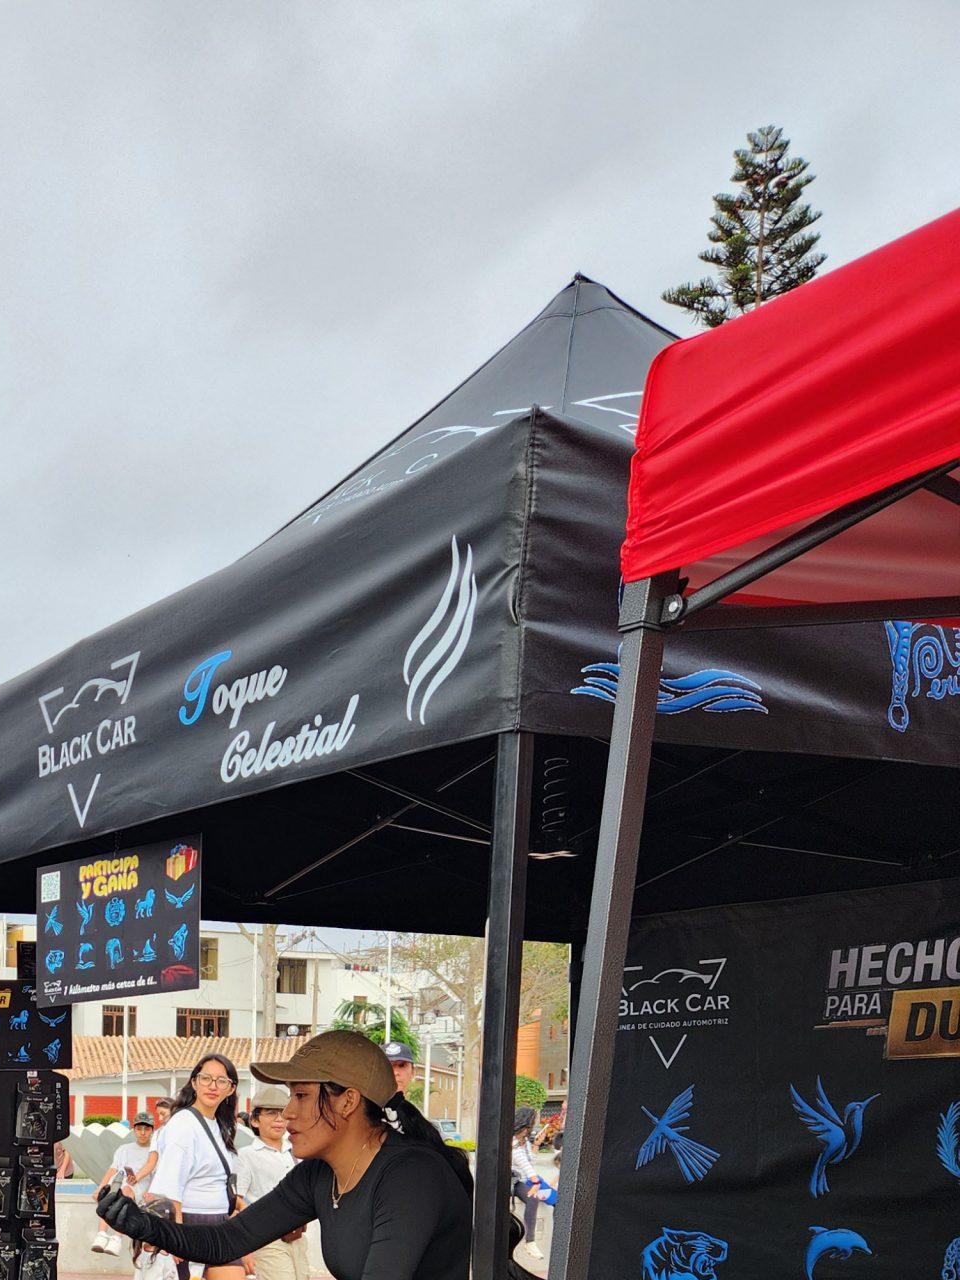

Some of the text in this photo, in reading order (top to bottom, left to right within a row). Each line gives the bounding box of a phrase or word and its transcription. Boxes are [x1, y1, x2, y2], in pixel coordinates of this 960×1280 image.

[178, 650, 288, 729] Toque
[38, 715, 137, 778] BLACK CAR
[220, 694, 360, 784] Celestial
[79, 855, 139, 882] PARTICIPA
[93, 870, 138, 897] GANA
[116, 979, 135, 989] cerca
[137, 975, 145, 987] de
[618, 993, 730, 1017] BLACK CAR
[825, 992, 881, 1018] PARA
[638, 1022, 647, 1030] DE
[648, 1020, 681, 1029] CUIDADO
[682, 1018, 729, 1027] AUTOMOTRIZ
